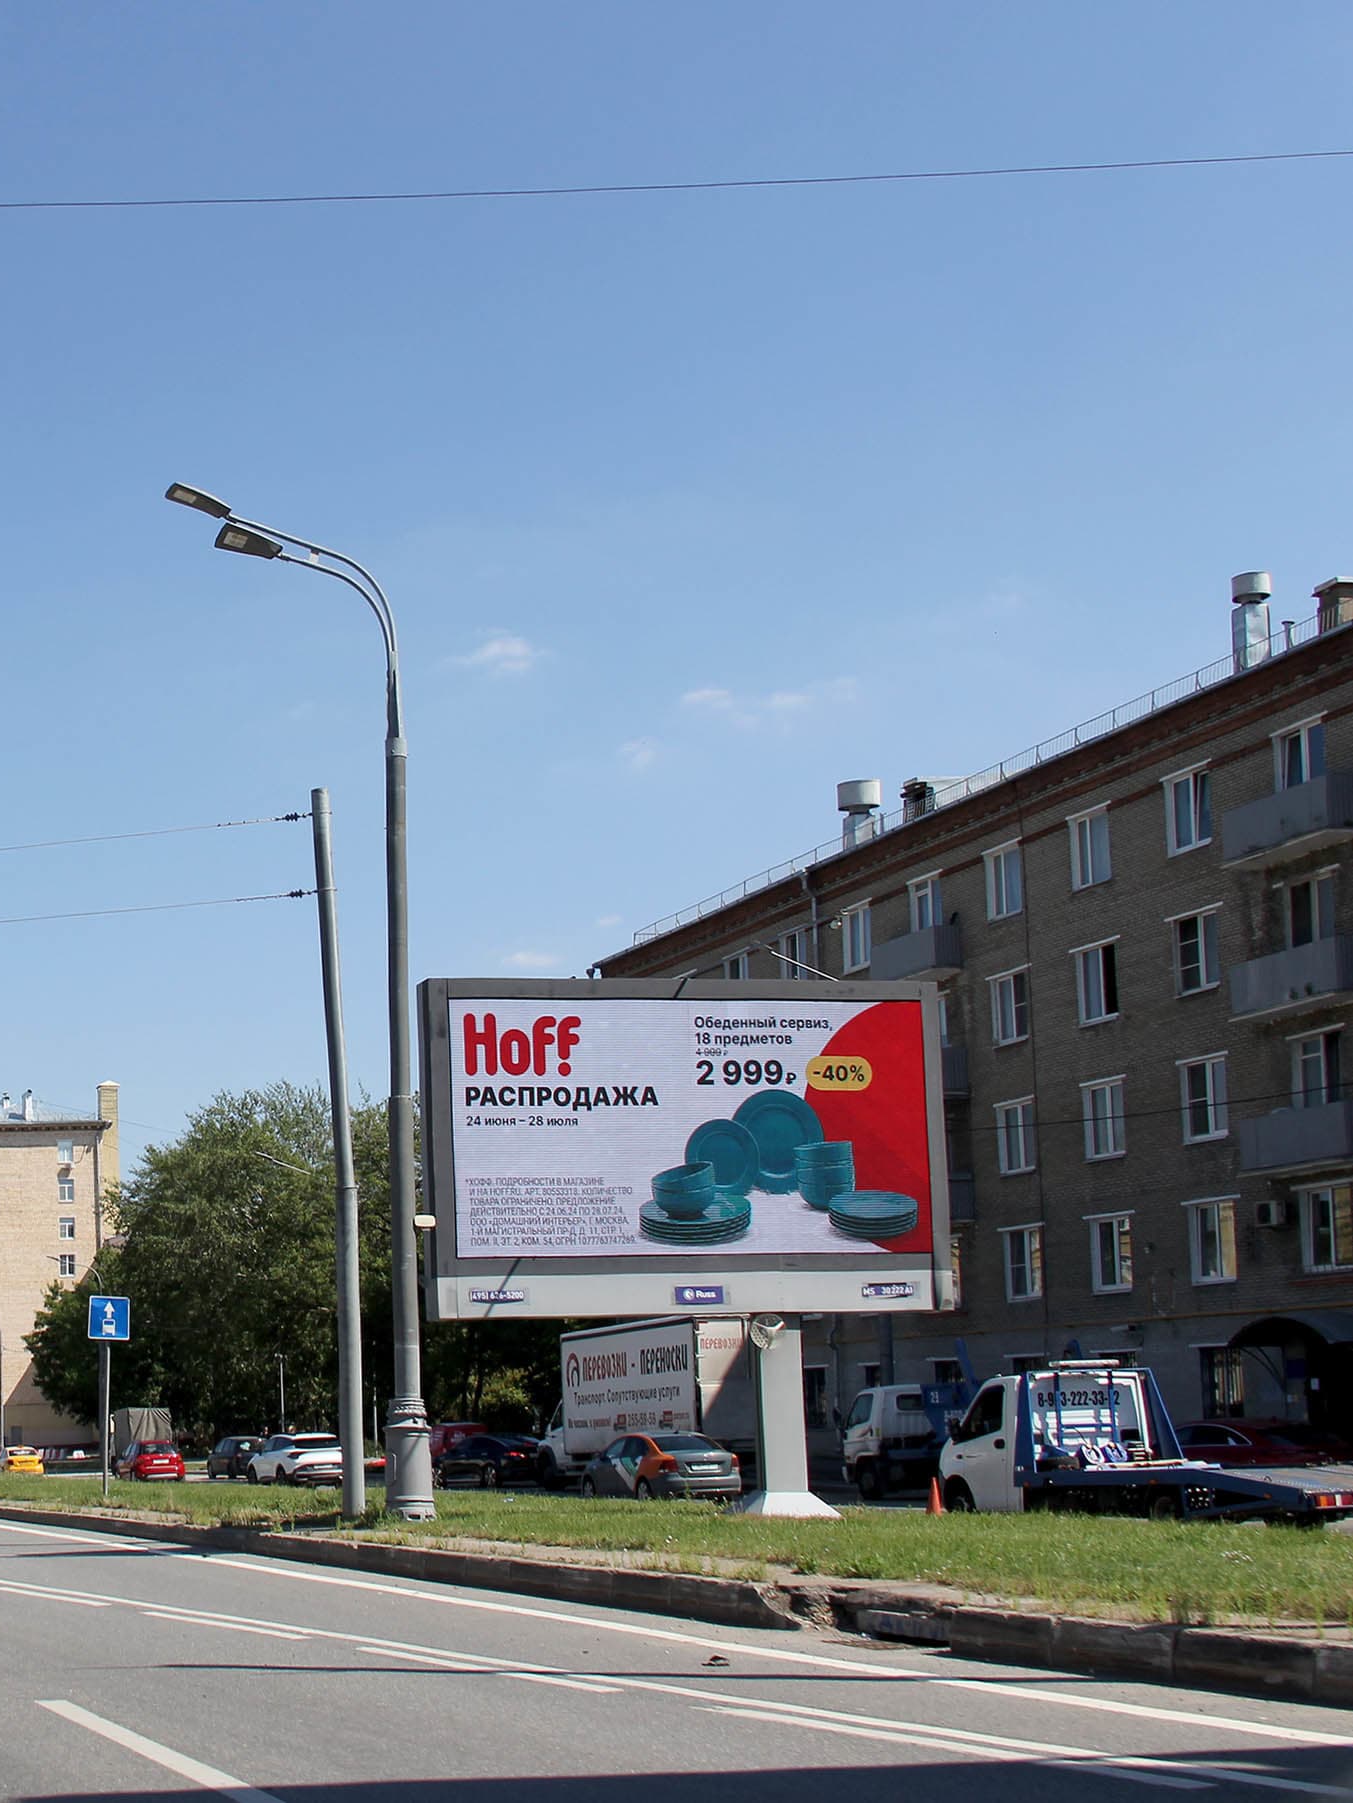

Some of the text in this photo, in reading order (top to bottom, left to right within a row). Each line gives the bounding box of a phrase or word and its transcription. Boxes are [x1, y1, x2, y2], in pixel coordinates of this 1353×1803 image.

[694, 1016, 833, 1031] Обеденный сервиз,
[695, 1033, 793, 1047] 18 предметов
[813, 1065, 866, 1083] -40%
[465, 1086, 659, 1111] РАСПРОДАЖА
[466, 1116, 481, 1126] 24
[484, 1117, 516, 1126] июня
[529, 1116, 544, 1126] 28
[547, 1117, 579, 1126] июля
[496, 1177, 554, 1186] ПОДРОБНОСТИ
[563, 1177, 604, 1186] МАГАЗИНЕ
[582, 1187, 633, 1196] КОЛИЧЕСТВО
[470, 1197, 499, 1206] ТОВАРА
[556, 1197, 616, 1206] ПРЕДЛОЖЕНИЕ
[470, 1207, 537, 1216] ДЕЙСТВИТЕЛЬНО
[471, 1216, 487, 1225] ООО
[485, 1226, 555, 1235] МАГИСТРАЛЬНЫЙ
[583, 1352, 627, 1382] ПЕРЕВОЗКИ
[640, 1344, 688, 1376] ПЕРЕНОСКИ
[657, 1386, 680, 1401] услуги
[1038, 1390, 1120, 1407] 8-93-222-33-2
